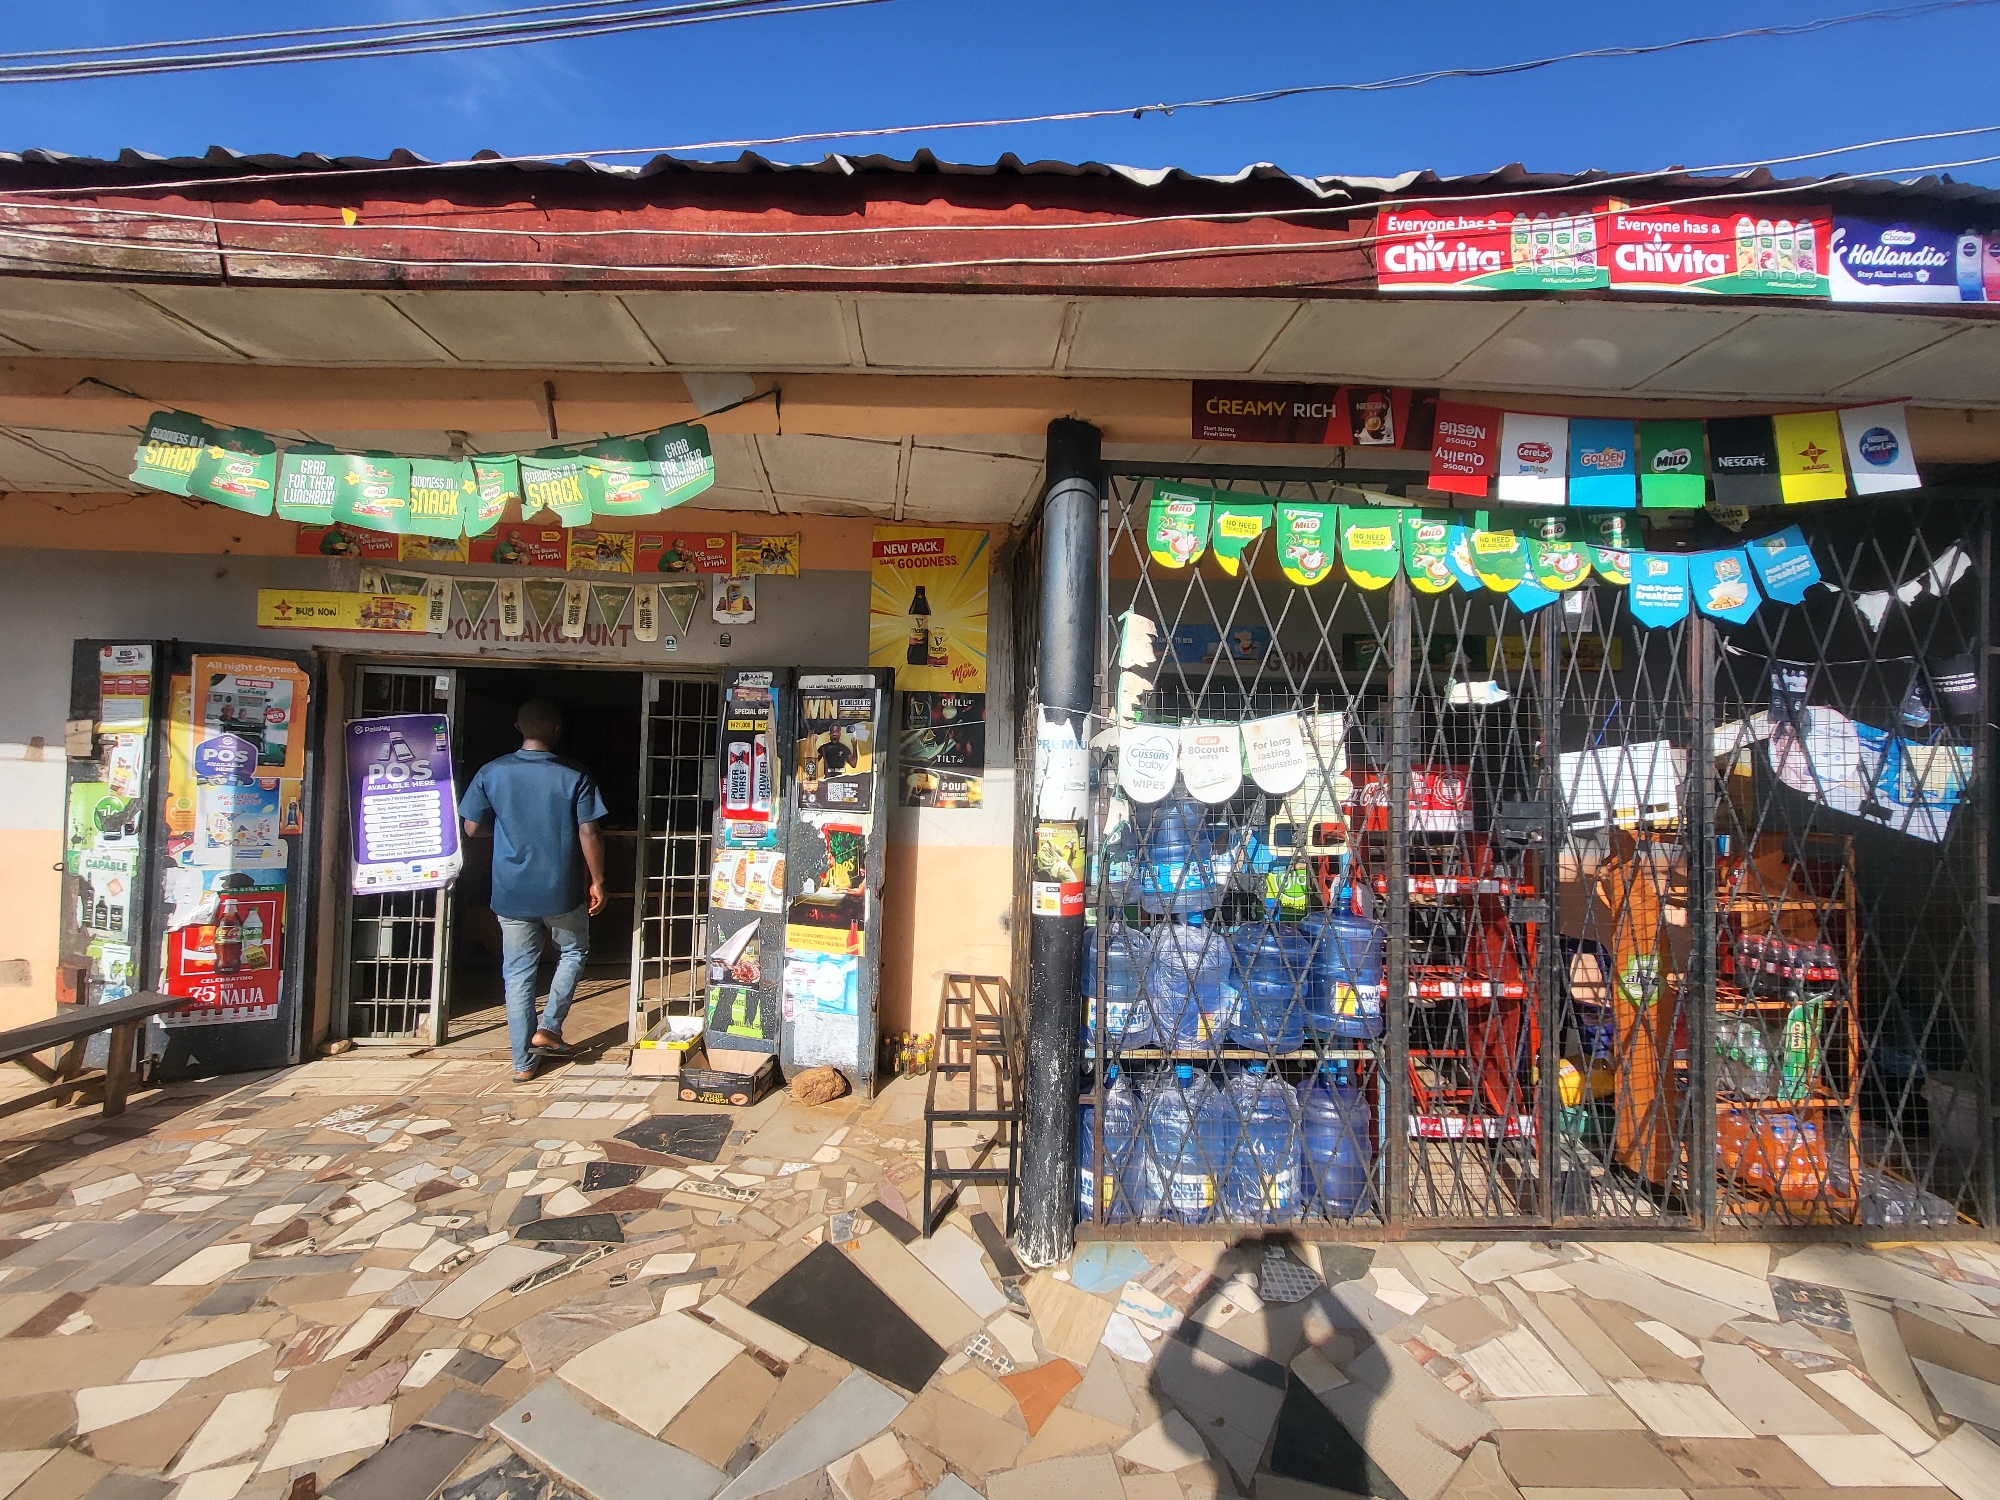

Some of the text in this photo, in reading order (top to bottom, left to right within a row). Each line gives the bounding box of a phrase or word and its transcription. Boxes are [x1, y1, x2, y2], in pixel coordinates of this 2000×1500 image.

[1387, 217, 1484, 232] Everyone has
[1617, 216, 1720, 234] Everyone has a
[1384, 239, 1501, 272] Chivita
[1615, 240, 1725, 274] Chivita
[1848, 244, 1948, 266] Hollandia
[1206, 399, 1337, 418] CREAMY RICH
[664, 438, 690, 457] GRAB
[1445, 437, 1477, 447] Choose
[1435, 448, 1485, 466] Quality
[1518, 447, 1550, 458] Cerelac
[1582, 451, 1624, 465] GOLDEN
[659, 448, 706, 476] FOR THEIR
[1598, 461, 1622, 469] MORN
[1656, 454, 1688, 467] MILO
[230, 464, 251, 476] MILO
[300, 459, 326, 476] GRAB
[524, 465, 562, 483] GOODNESS
[1443, 463, 1474, 474] Choose
[1519, 464, 1549, 474] junior
[1803, 464, 1830, 472] MAGGI
[611, 473, 629, 485] MILO
[661, 459, 709, 491] LUNCHBOX!
[288, 474, 336, 490] FOR THEIR
[283, 487, 336, 506] LUNCHBOX!
[527, 475, 584, 508] SNACK
[1169, 505, 1193, 513] MILO
[1238, 522, 1257, 530] NEED
[1294, 521, 1317, 529] MILO
[1542, 526, 1564, 535] MILO
[1602, 521, 1623, 532] MILO
[1420, 529, 1442, 538] MILO
[883, 543, 909, 555] NEW
[537, 552, 561, 560] Irinki
[880, 558, 895, 566] SAME
[704, 559, 727, 568] Irinki
[1767, 560, 1811, 584] Breakfast
[1635, 591, 1683, 601] Breakfast
[295, 607, 336, 616] BUY NOW
[430, 601, 438, 620] POWER
[436, 601, 444, 621] HORSE
[574, 605, 582, 624] HORSE
[207, 661, 299, 675] All night dryness
[951, 664, 978, 683] Move
[803, 699, 838, 719] WIN
[942, 698, 967, 707] CHILL
[1188, 745, 1229, 754] 80count
[1270, 737, 1291, 749] long
[203, 749, 249, 763] POS
[937, 755, 957, 763] TILT
[1131, 749, 1170, 761] Cussons
[1257, 749, 1291, 760] lasting
[368, 760, 433, 784] POS
[1138, 759, 1164, 772] baby
[1251, 757, 1303, 774] moisturisation
[367, 780, 436, 791] AVAILABLE HERE
[731, 769, 740, 800] POWER
[739, 769, 747, 800] HORSE
[759, 761, 768, 797] POWER
[1133, 778, 1166, 790] WIPES
[942, 782, 968, 791] POUR
[171, 842, 186, 854] NEW
[85, 859, 128, 872] CAPABLE
[200, 975, 254, 984] CELEBRATING
[189, 985, 216, 1002] 75
[220, 987, 264, 1006] NAIJA
